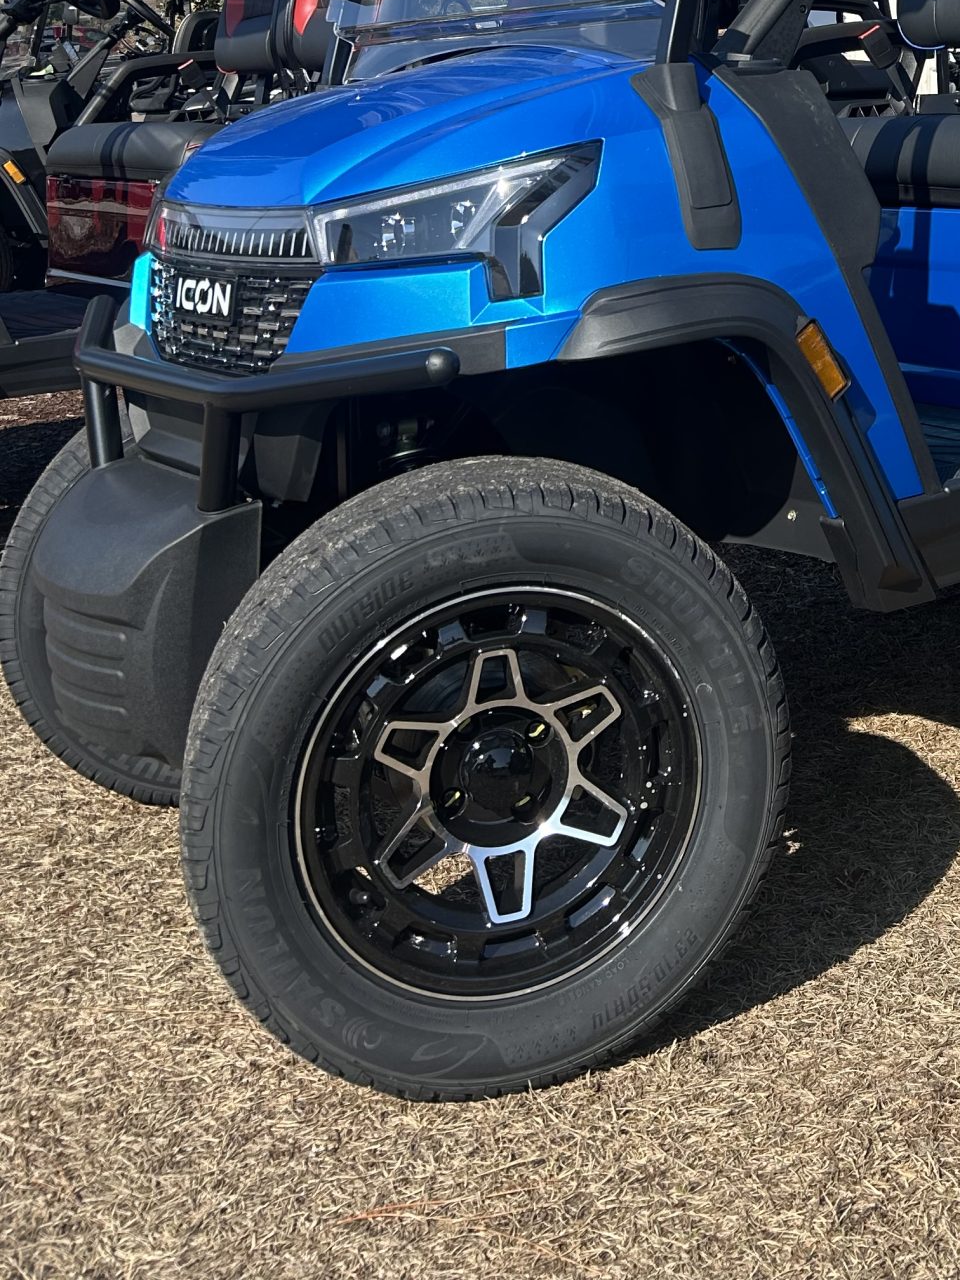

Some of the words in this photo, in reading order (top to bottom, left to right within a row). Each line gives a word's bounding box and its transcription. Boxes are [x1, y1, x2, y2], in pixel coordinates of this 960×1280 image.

[176, 277, 232, 317] ICON
[621, 556, 763, 733] SHUTTLE
[80, 739, 182, 783] HUTT
[235, 867, 346, 1027] SAILUN
